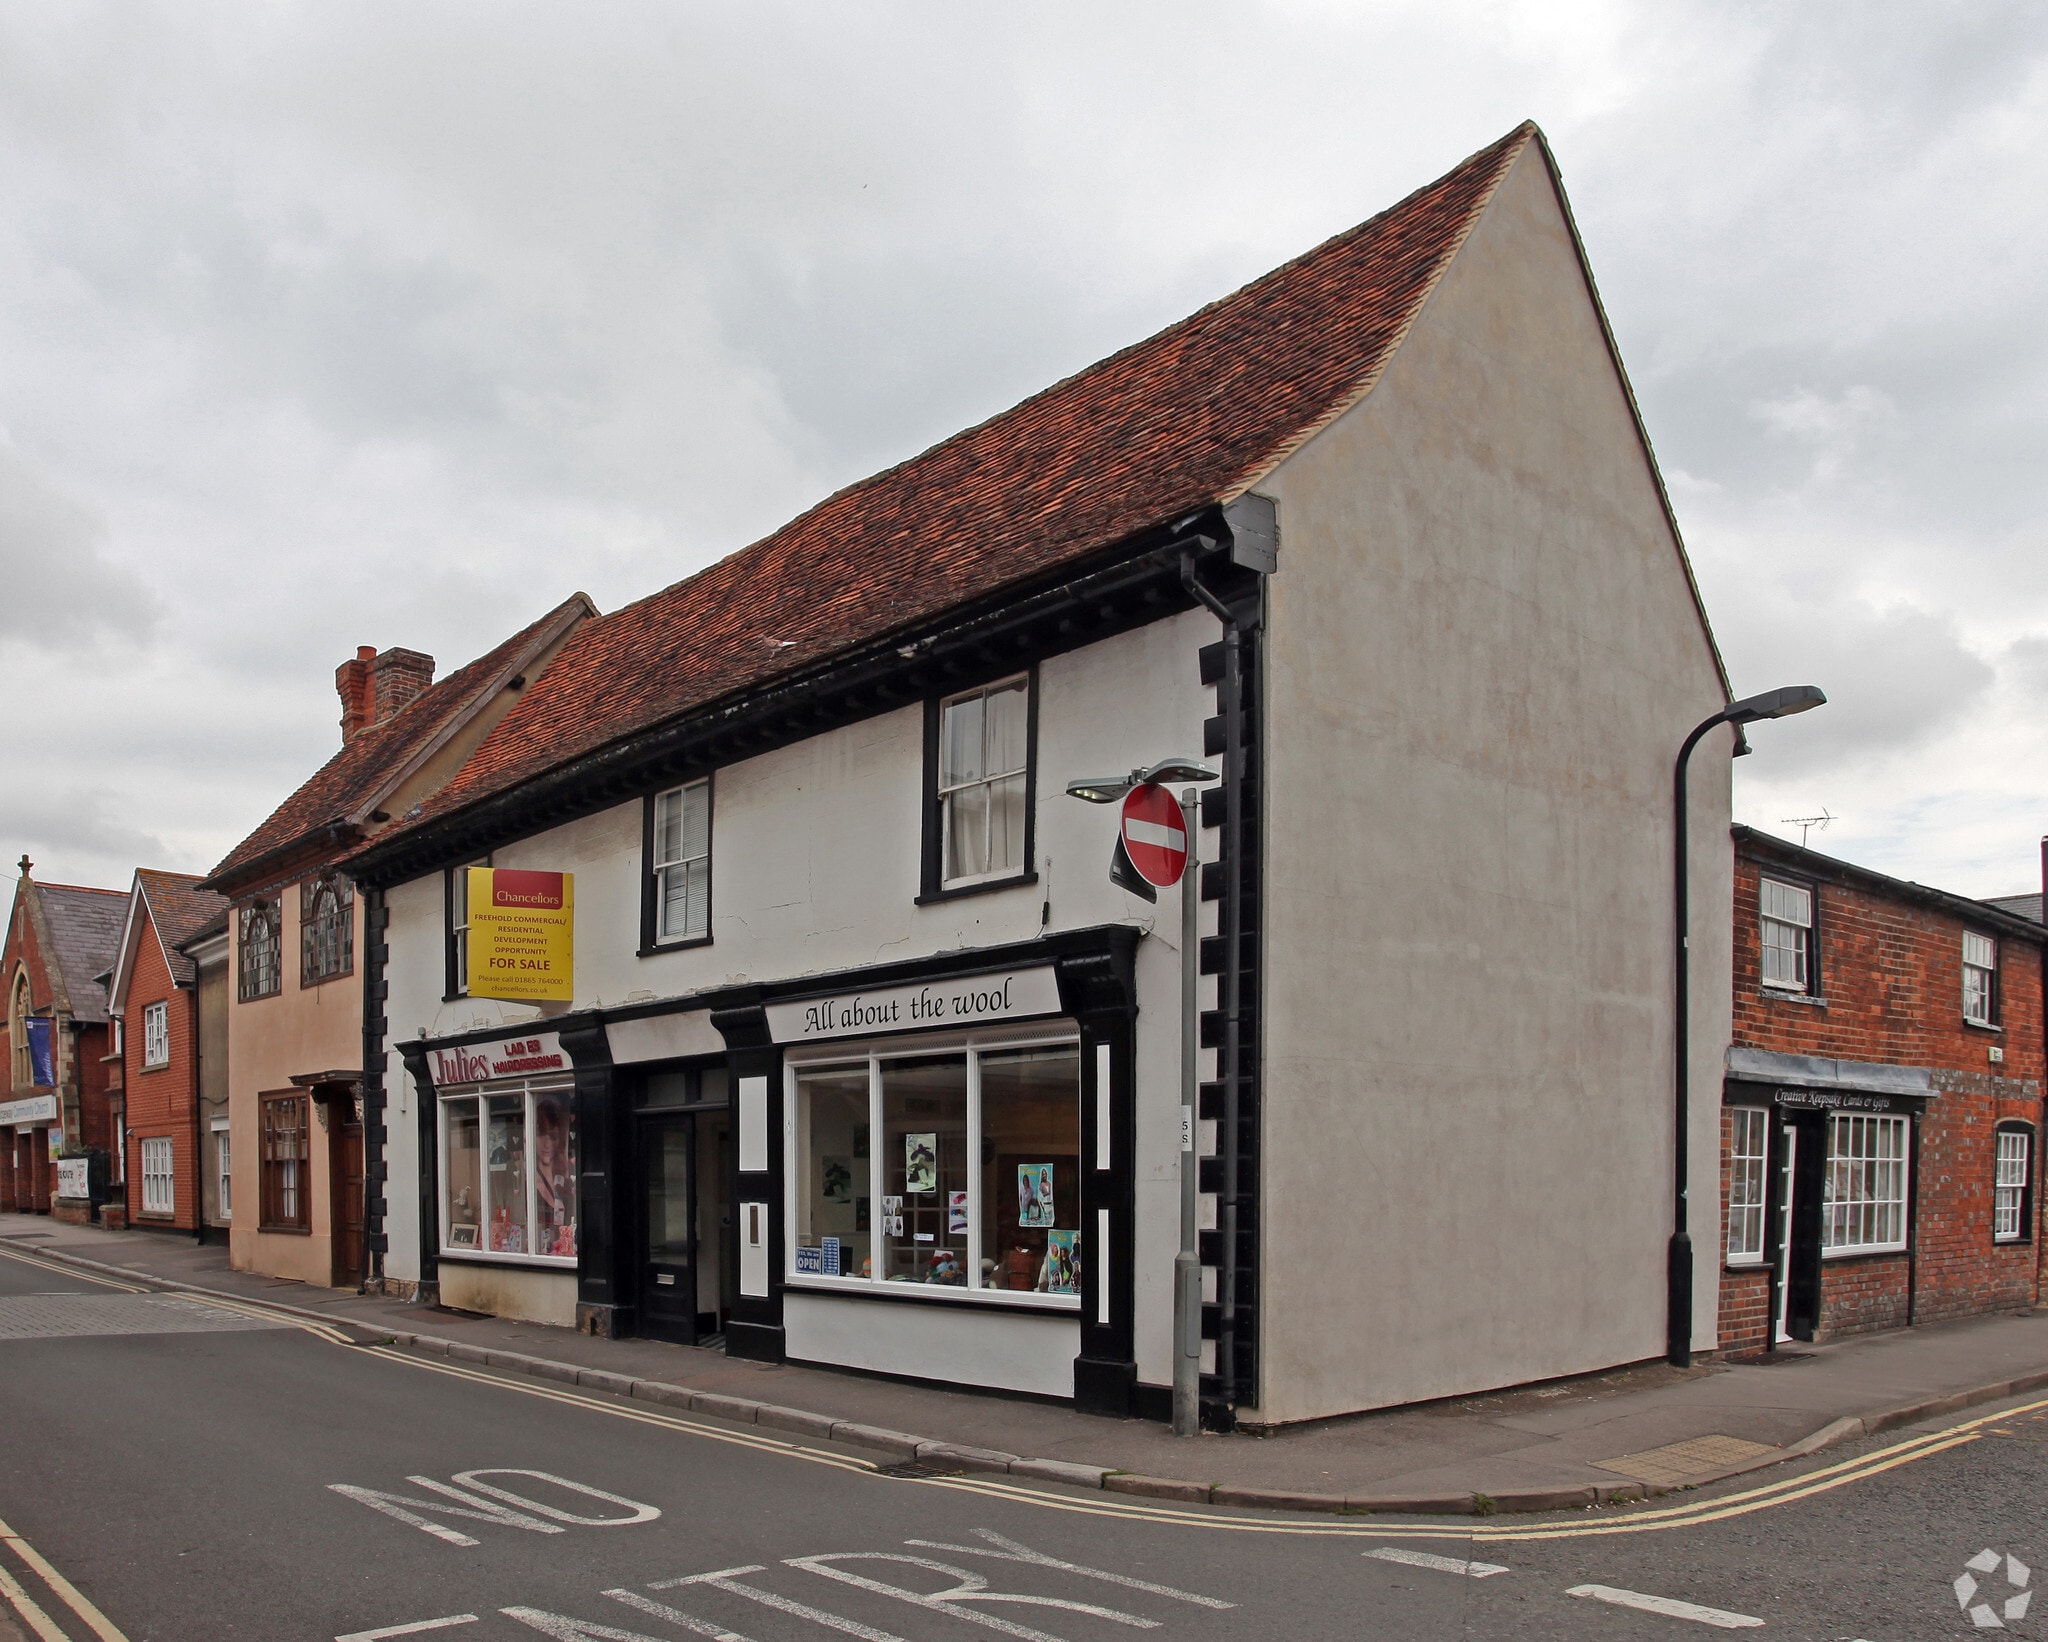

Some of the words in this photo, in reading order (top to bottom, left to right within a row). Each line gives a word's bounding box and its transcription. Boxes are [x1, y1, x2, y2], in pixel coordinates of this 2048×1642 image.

[496, 890, 559, 905] Chancellors
[474, 914, 512, 922] FREEHOLD
[514, 916, 567, 926] COMMERCIAL/
[498, 926, 544, 934] RESIDENTIAL
[494, 936, 548, 945] DEVELOPMENT
[495, 946, 547, 955] OPPORTUNITY
[489, 958, 516, 969] FOR
[520, 959, 551, 970] SALE
[478, 975, 500, 983] Please
[514, 976, 536, 984] 01865
[537, 977, 564, 985] 764000
[491, 985, 548, 994] chancellors.co.uk
[804, 1000, 835, 1032] All
[841, 997, 901, 1028] about
[910, 987, 946, 1020] the
[951, 976, 1013, 1015] wool
[435, 1046, 490, 1083] Julies
[492, 1053, 563, 1074] HAIRDRESSING
[1774, 1088, 1807, 1103] Creative
[1808, 1090, 1841, 1108] Keepsake
[1843, 1094, 1862, 1107] Cards
[1872, 1096, 1890, 1111] Gifts
[1182, 1121, 1188, 1130] 5
[797, 1257, 819, 1270] OPEN
[325, 1468, 661, 1547] NO
[334, 1527, 1244, 1642] NTRY
